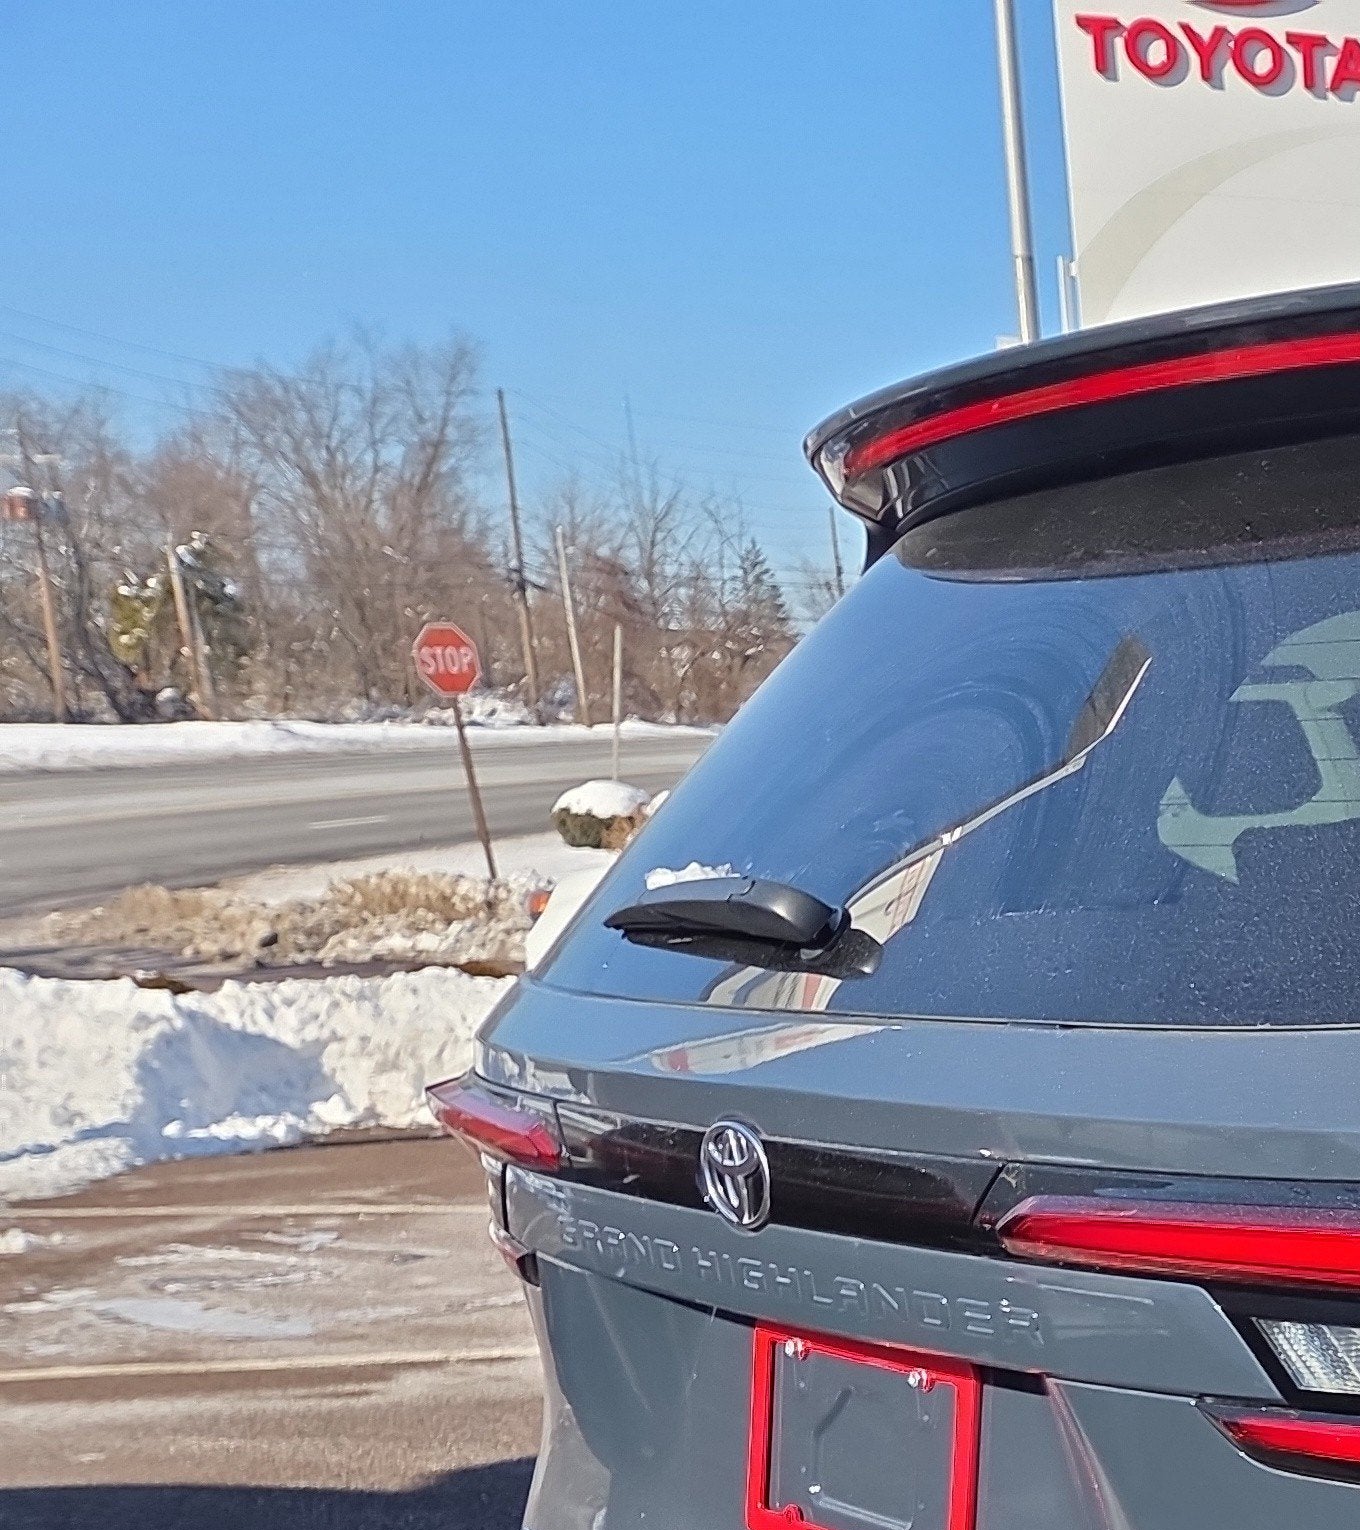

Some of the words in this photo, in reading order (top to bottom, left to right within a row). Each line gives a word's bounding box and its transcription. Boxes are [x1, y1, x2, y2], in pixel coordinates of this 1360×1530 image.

[419, 645, 474, 676] STOP
[557, 1213, 681, 1272] GRAND
[691, 1245, 1046, 1349] HIGHLANDER
